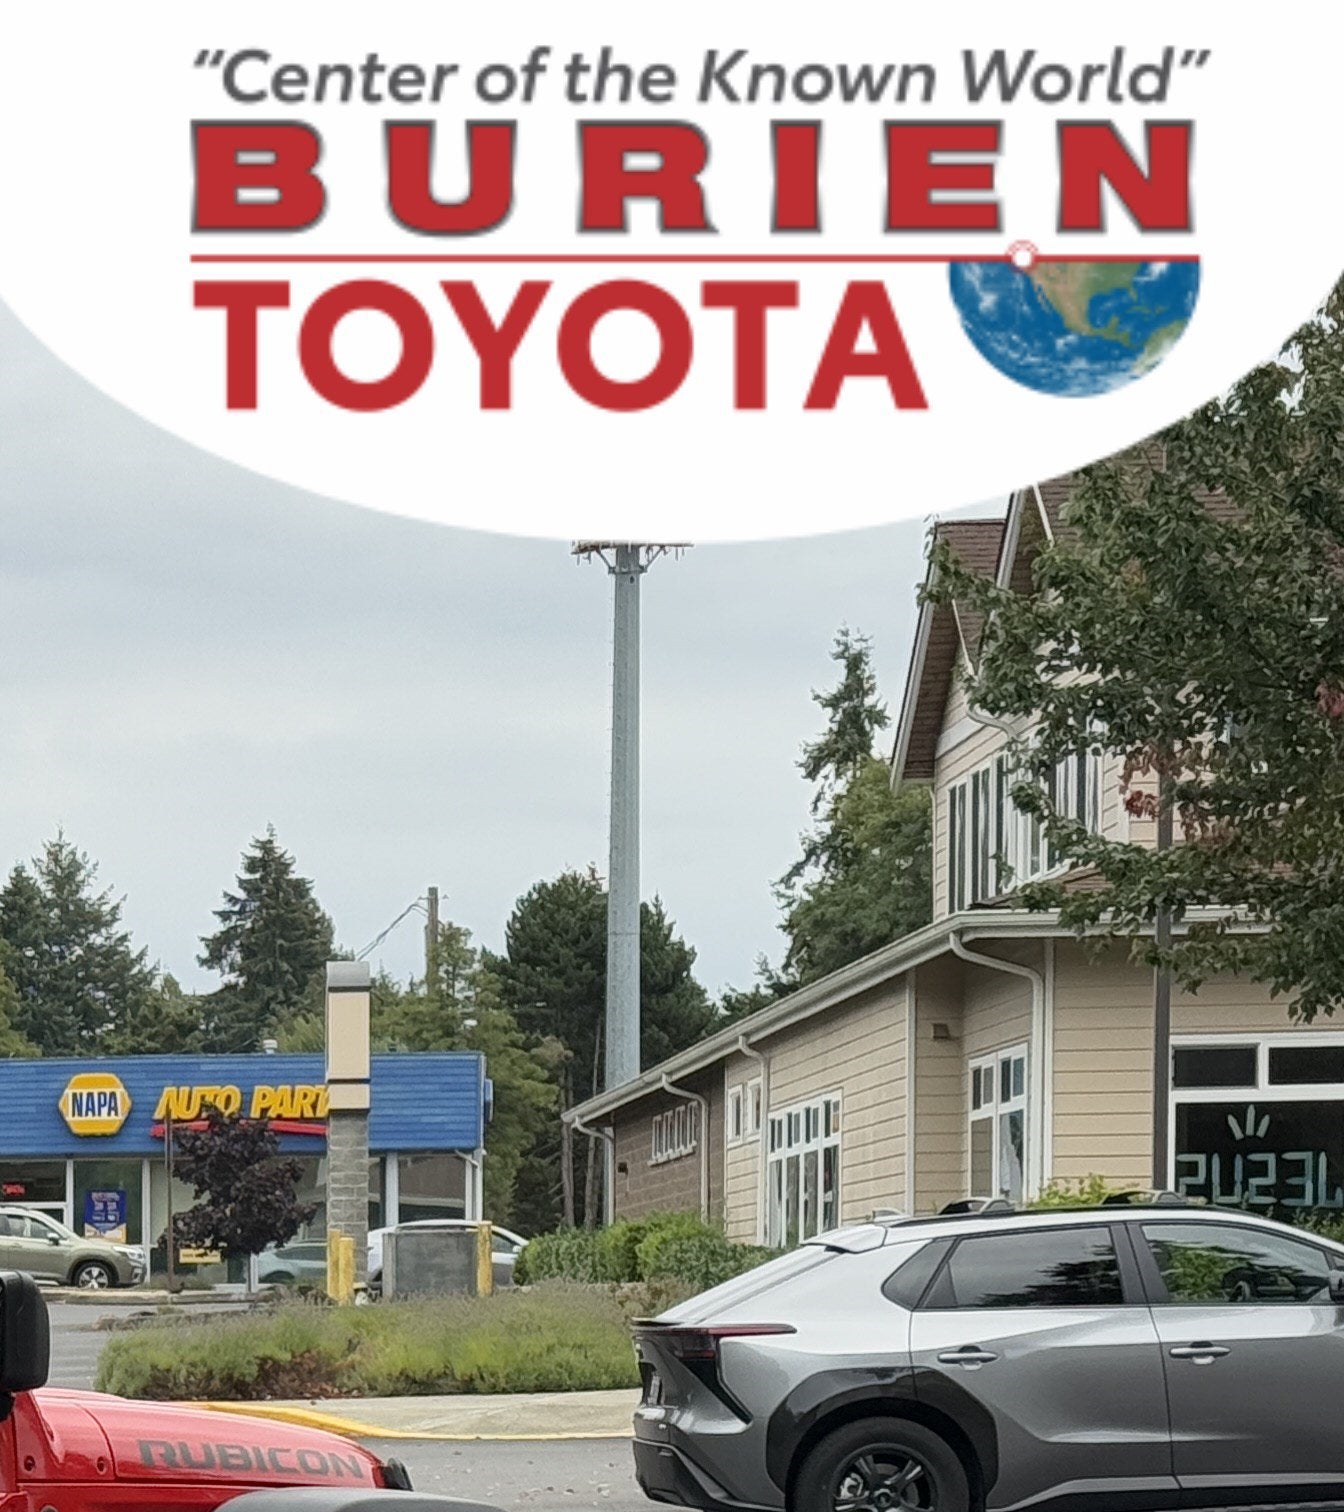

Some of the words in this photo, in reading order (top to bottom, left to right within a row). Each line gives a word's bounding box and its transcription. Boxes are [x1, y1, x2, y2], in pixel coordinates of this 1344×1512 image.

[72, 1091, 119, 1118] NAPA
[154, 1086, 241, 1119] AUTO
[250, 1084, 330, 1119] PART
[138, 1439, 364, 1479] RUBICON
